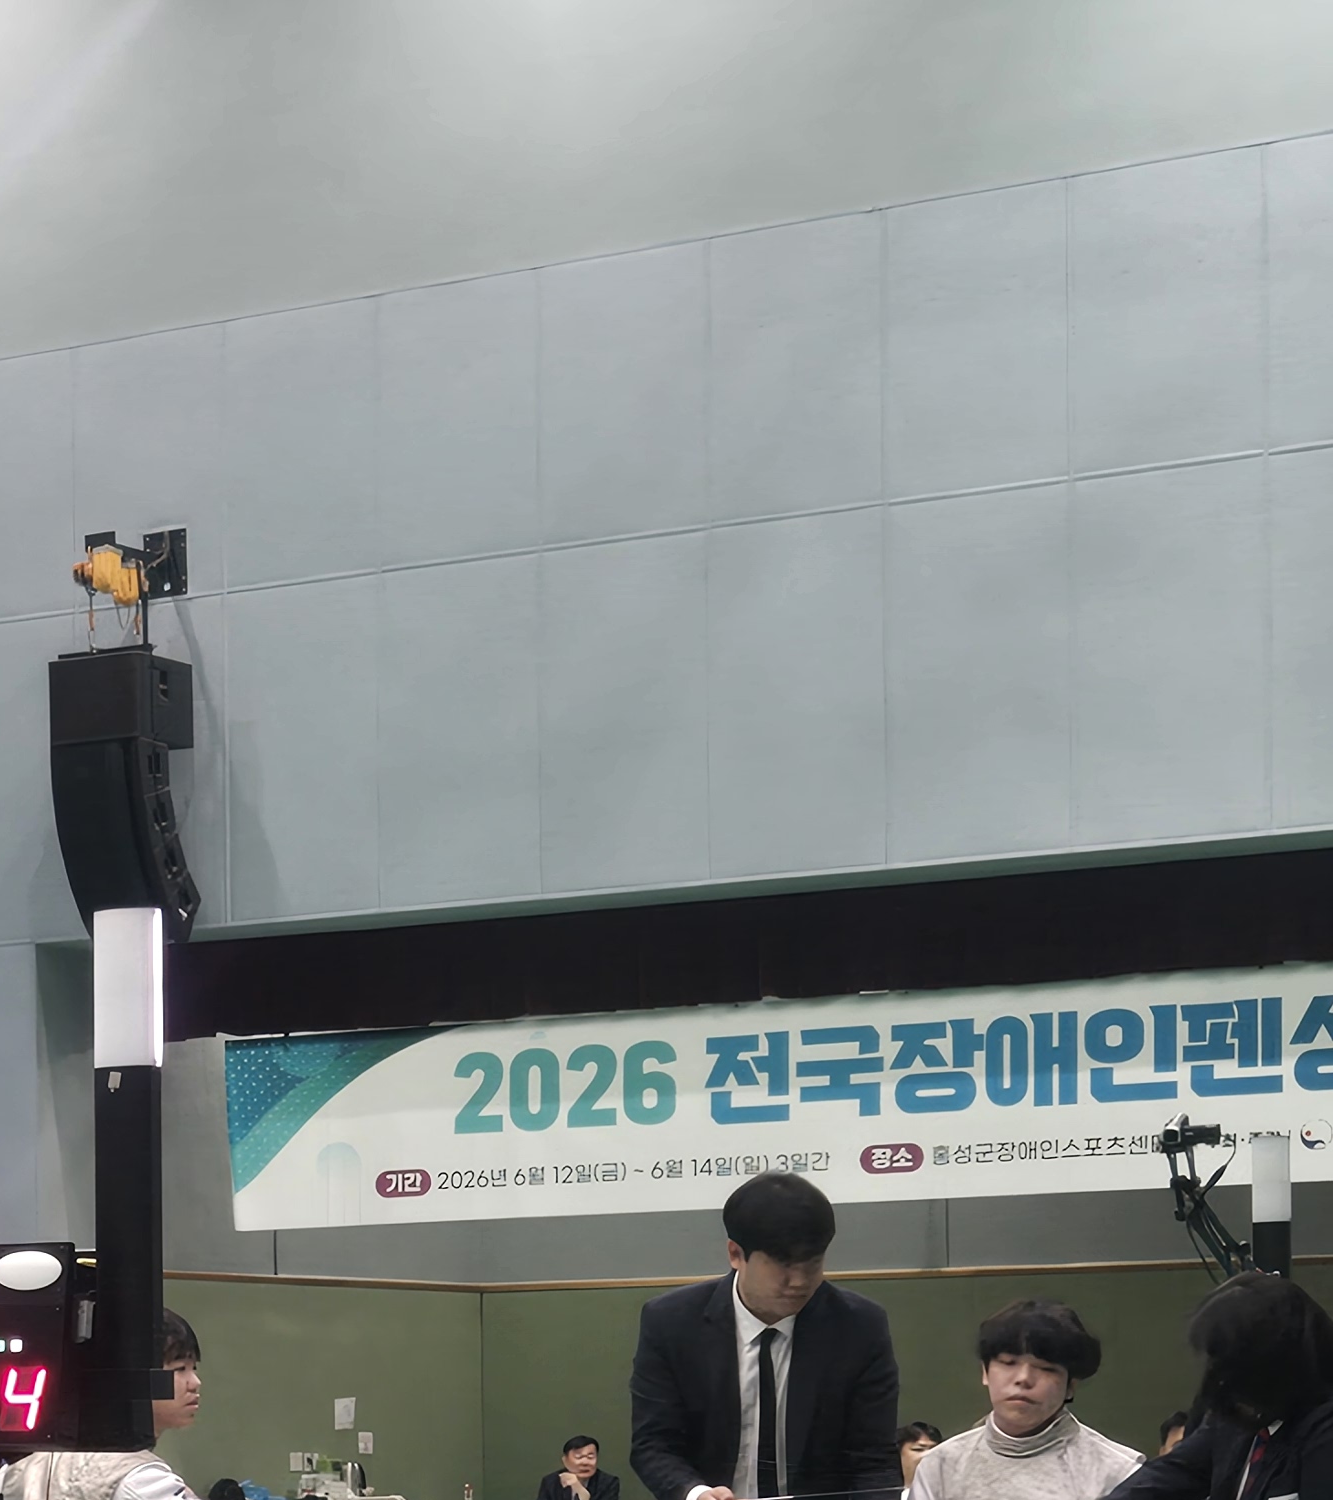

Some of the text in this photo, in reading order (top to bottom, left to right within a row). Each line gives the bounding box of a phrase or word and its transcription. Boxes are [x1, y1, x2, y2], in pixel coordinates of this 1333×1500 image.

[453, 1039, 678, 1135] 2026
[385, 1172, 423, 1194] 기간
[437, 1168, 508, 1190] 2026년
[514, 1165, 546, 1187] 6월
[552, 1161, 627, 1185] 12일(금)
[650, 1158, 684, 1180] 6월
[690, 1154, 769, 1178] 14일(일)
[775, 1151, 831, 1173] 3일간
[870, 1147, 915, 1169] 장소
[4, 1367, 47, 1430] 4
